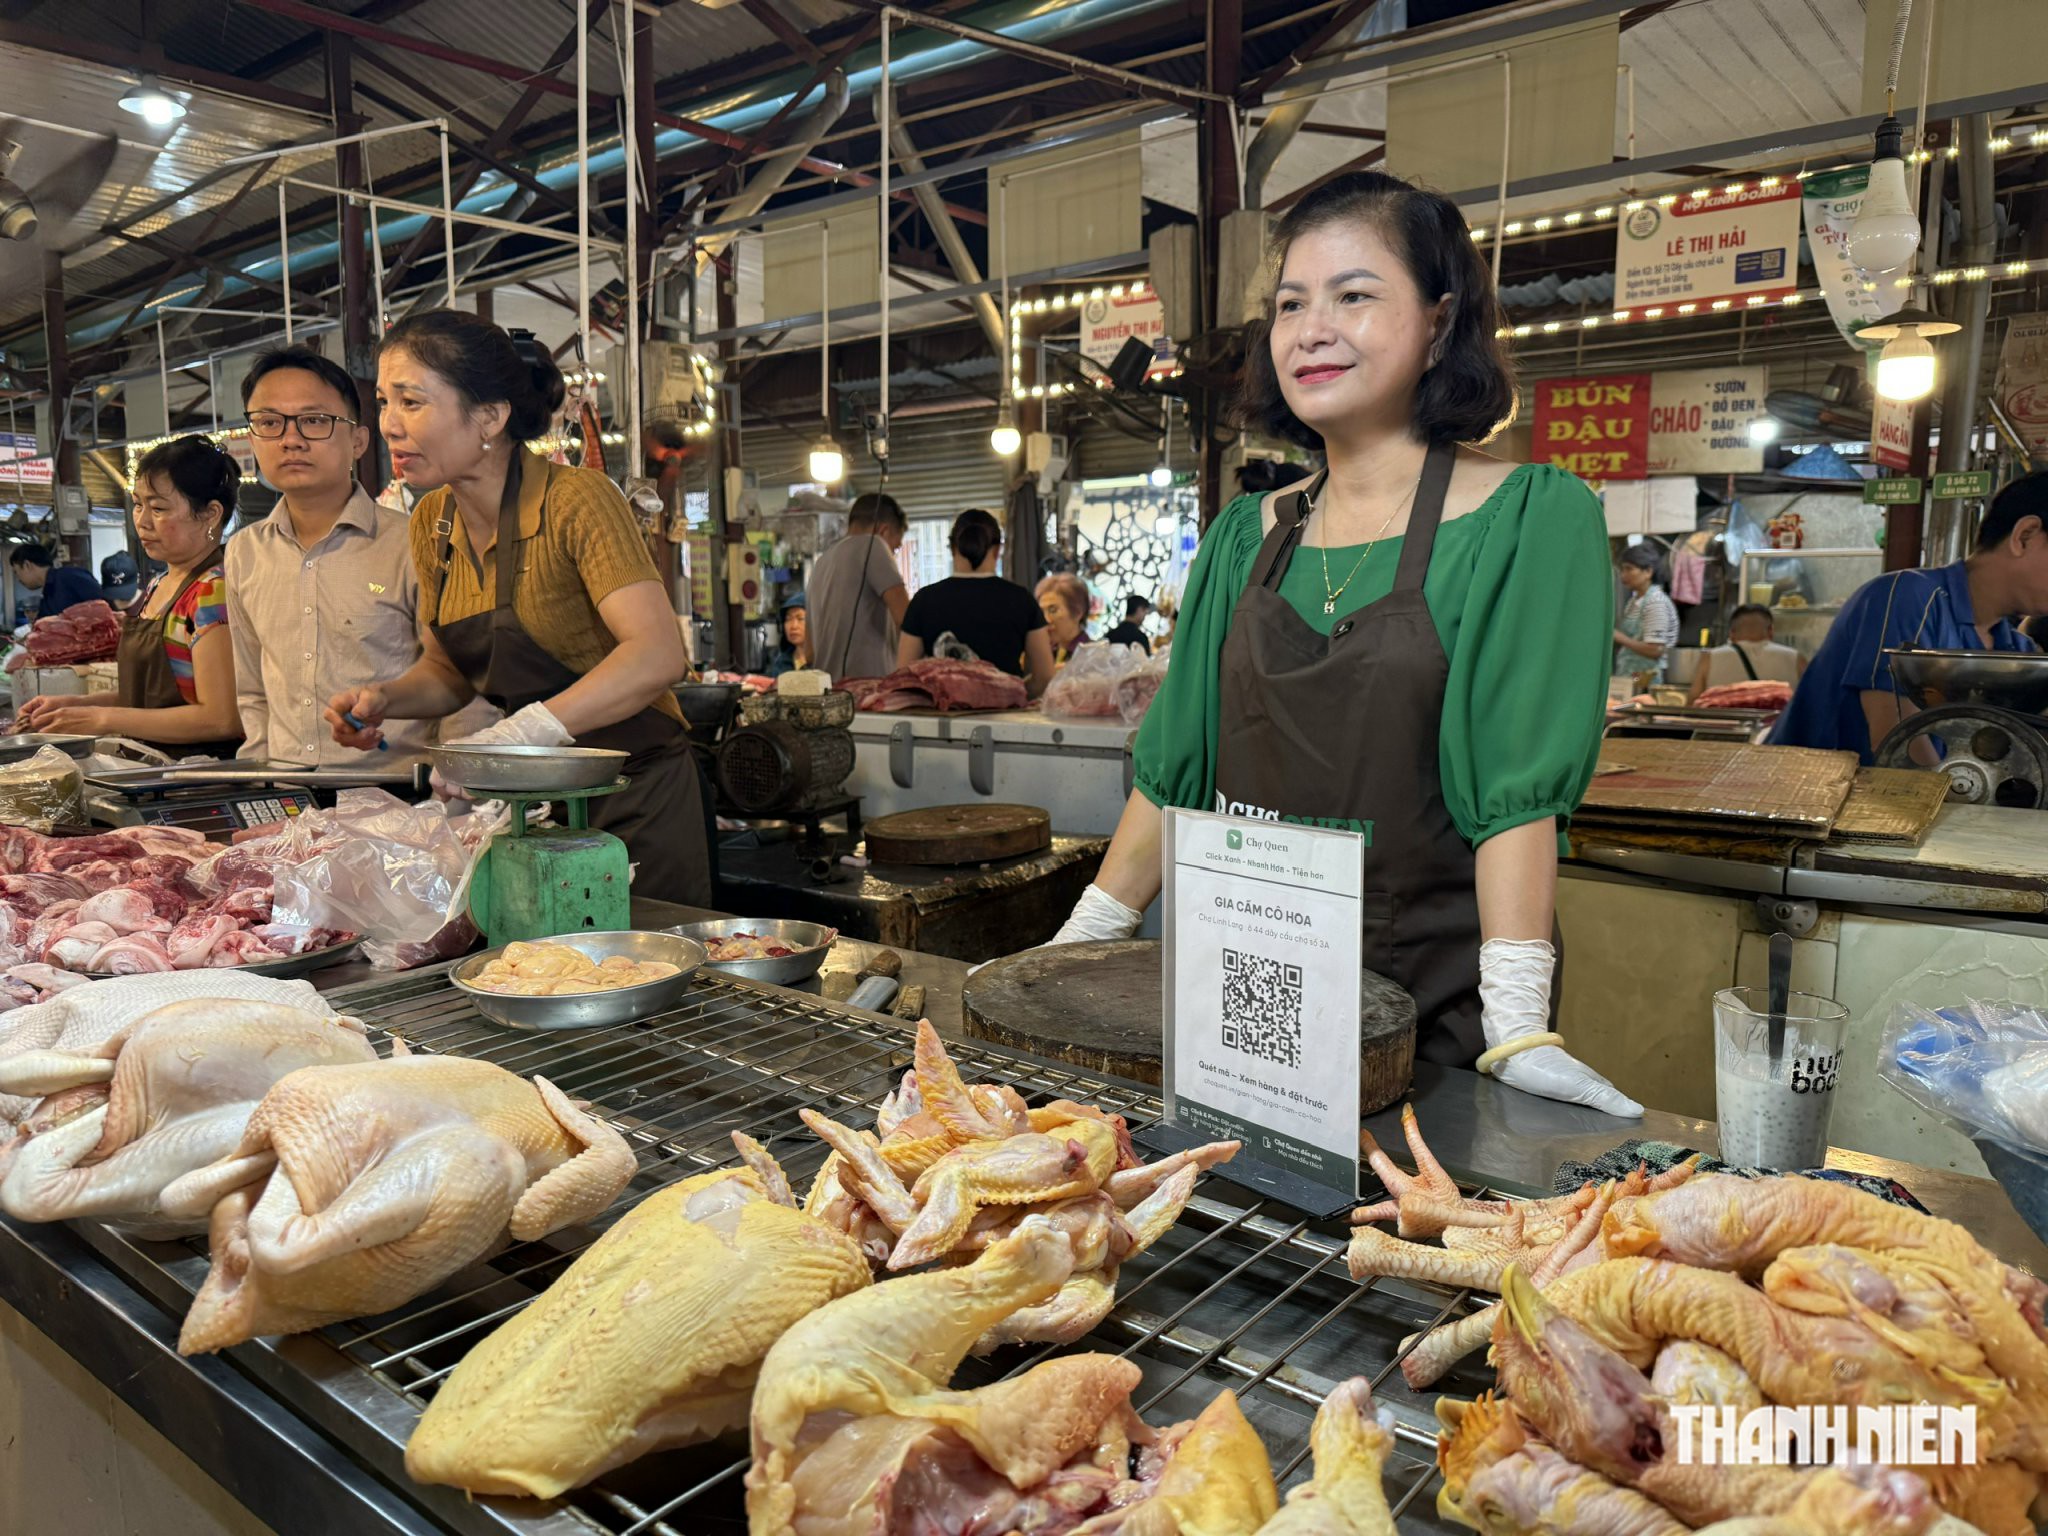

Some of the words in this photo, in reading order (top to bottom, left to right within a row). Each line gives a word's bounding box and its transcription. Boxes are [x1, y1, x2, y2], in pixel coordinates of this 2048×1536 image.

[1705, 193, 1736, 208] KINH
[1739, 185, 1788, 203] DOANH
[1666, 236, 1687, 257] LÊ
[1690, 235, 1714, 255] THỊ
[1719, 225, 1746, 249] HẢI
[1551, 380, 1634, 409] BÚN
[1730, 399, 1755, 412] ĐEN
[1548, 415, 1633, 445] ĐẬU
[1650, 400, 1702, 434] CHÁO
[1548, 452, 1629, 479] MẸT
[1246, 837, 1263, 850] Chợ
[1264, 840, 1289, 852] Quen
[1205, 852, 1223, 861] Click
[1224, 856, 1241, 864] Xanh
[1247, 859, 1269, 870] Nhanh
[1215, 896, 1234, 910] GIA
[1265, 905, 1283, 920] CÔ
[1286, 911, 1312, 927] HOA
[1213, 916, 1227, 926] Linh
[1228, 919, 1243, 932] Lang
[1319, 940, 1330, 949] 3A
[1198, 1060, 1217, 1073] Quét
[1239, 1073, 1257, 1087] Xem
[1258, 1079, 1279, 1095] hàng
[1280, 1087, 1287, 1096] &
[1288, 1090, 1303, 1104] đặt
[1304, 1096, 1328, 1111] trước
